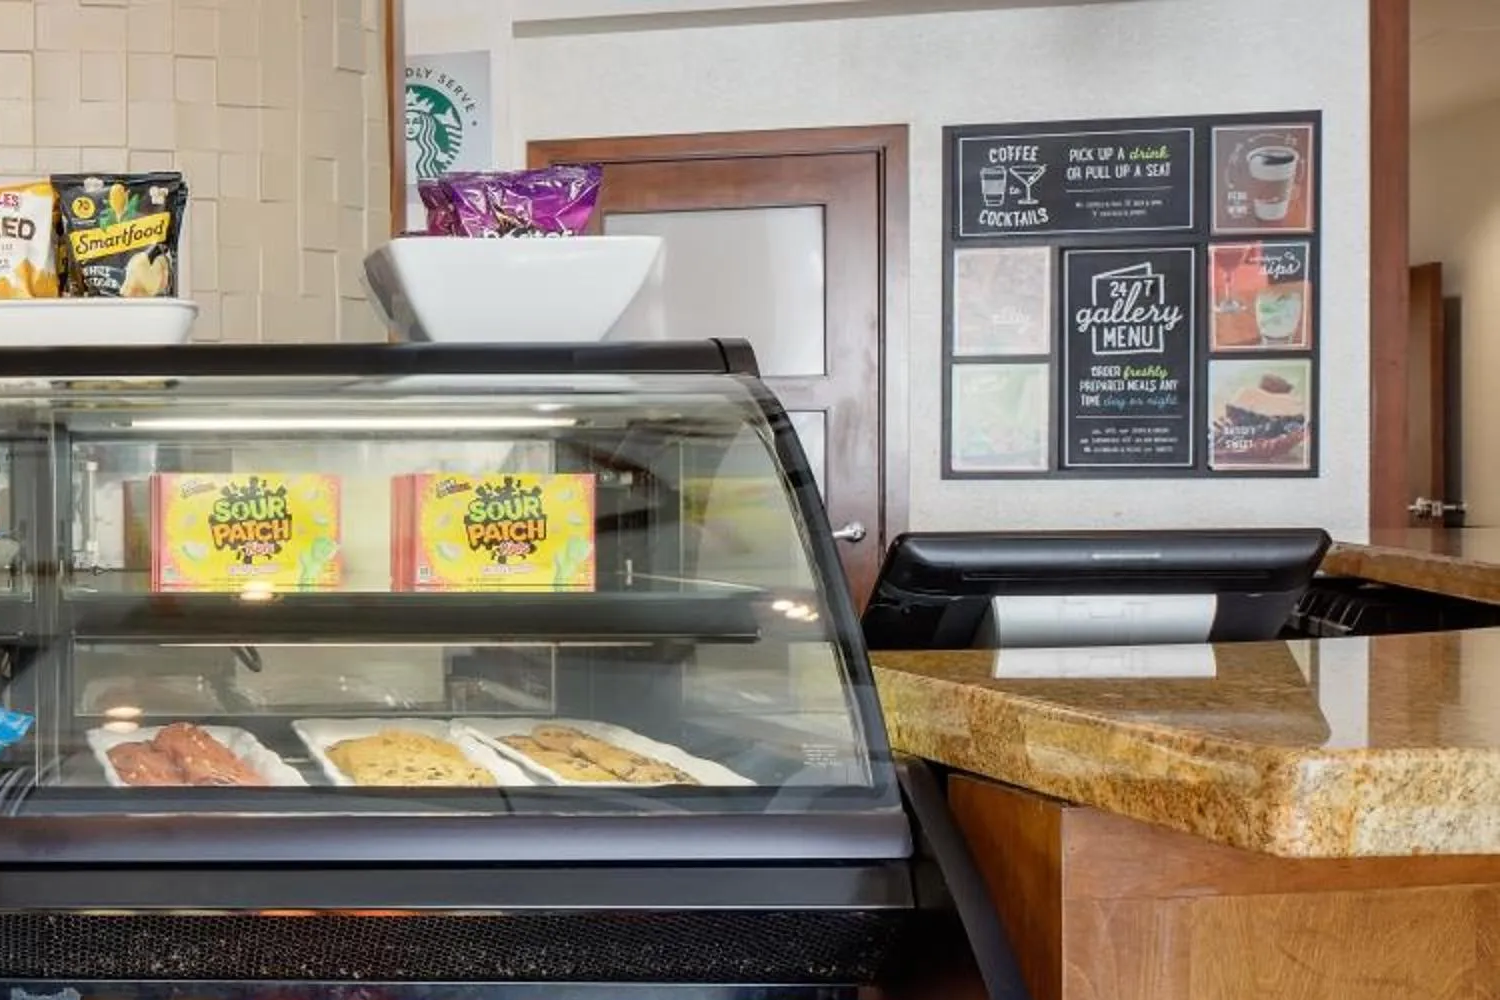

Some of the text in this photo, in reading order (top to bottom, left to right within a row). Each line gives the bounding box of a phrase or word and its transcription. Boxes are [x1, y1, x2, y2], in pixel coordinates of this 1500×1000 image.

[438, 73, 477, 113] SERVE
[989, 146, 1039, 163] COFFEE
[1069, 146, 1170, 162] PICK UP A drink
[1067, 162, 1171, 181] OR PULL UP A SEAT
[979, 207, 1049, 227] COCKTAILS
[75, 220, 166, 255] Smartfood
[1076, 281, 1183, 333] gallery
[1103, 325, 1154, 348] MENU
[1123, 365, 1168, 380] freshly
[214, 496, 287, 522] SOUR
[468, 495, 541, 522] SOUR
[212, 519, 290, 546] PATCH
[467, 519, 546, 546] PATCH
